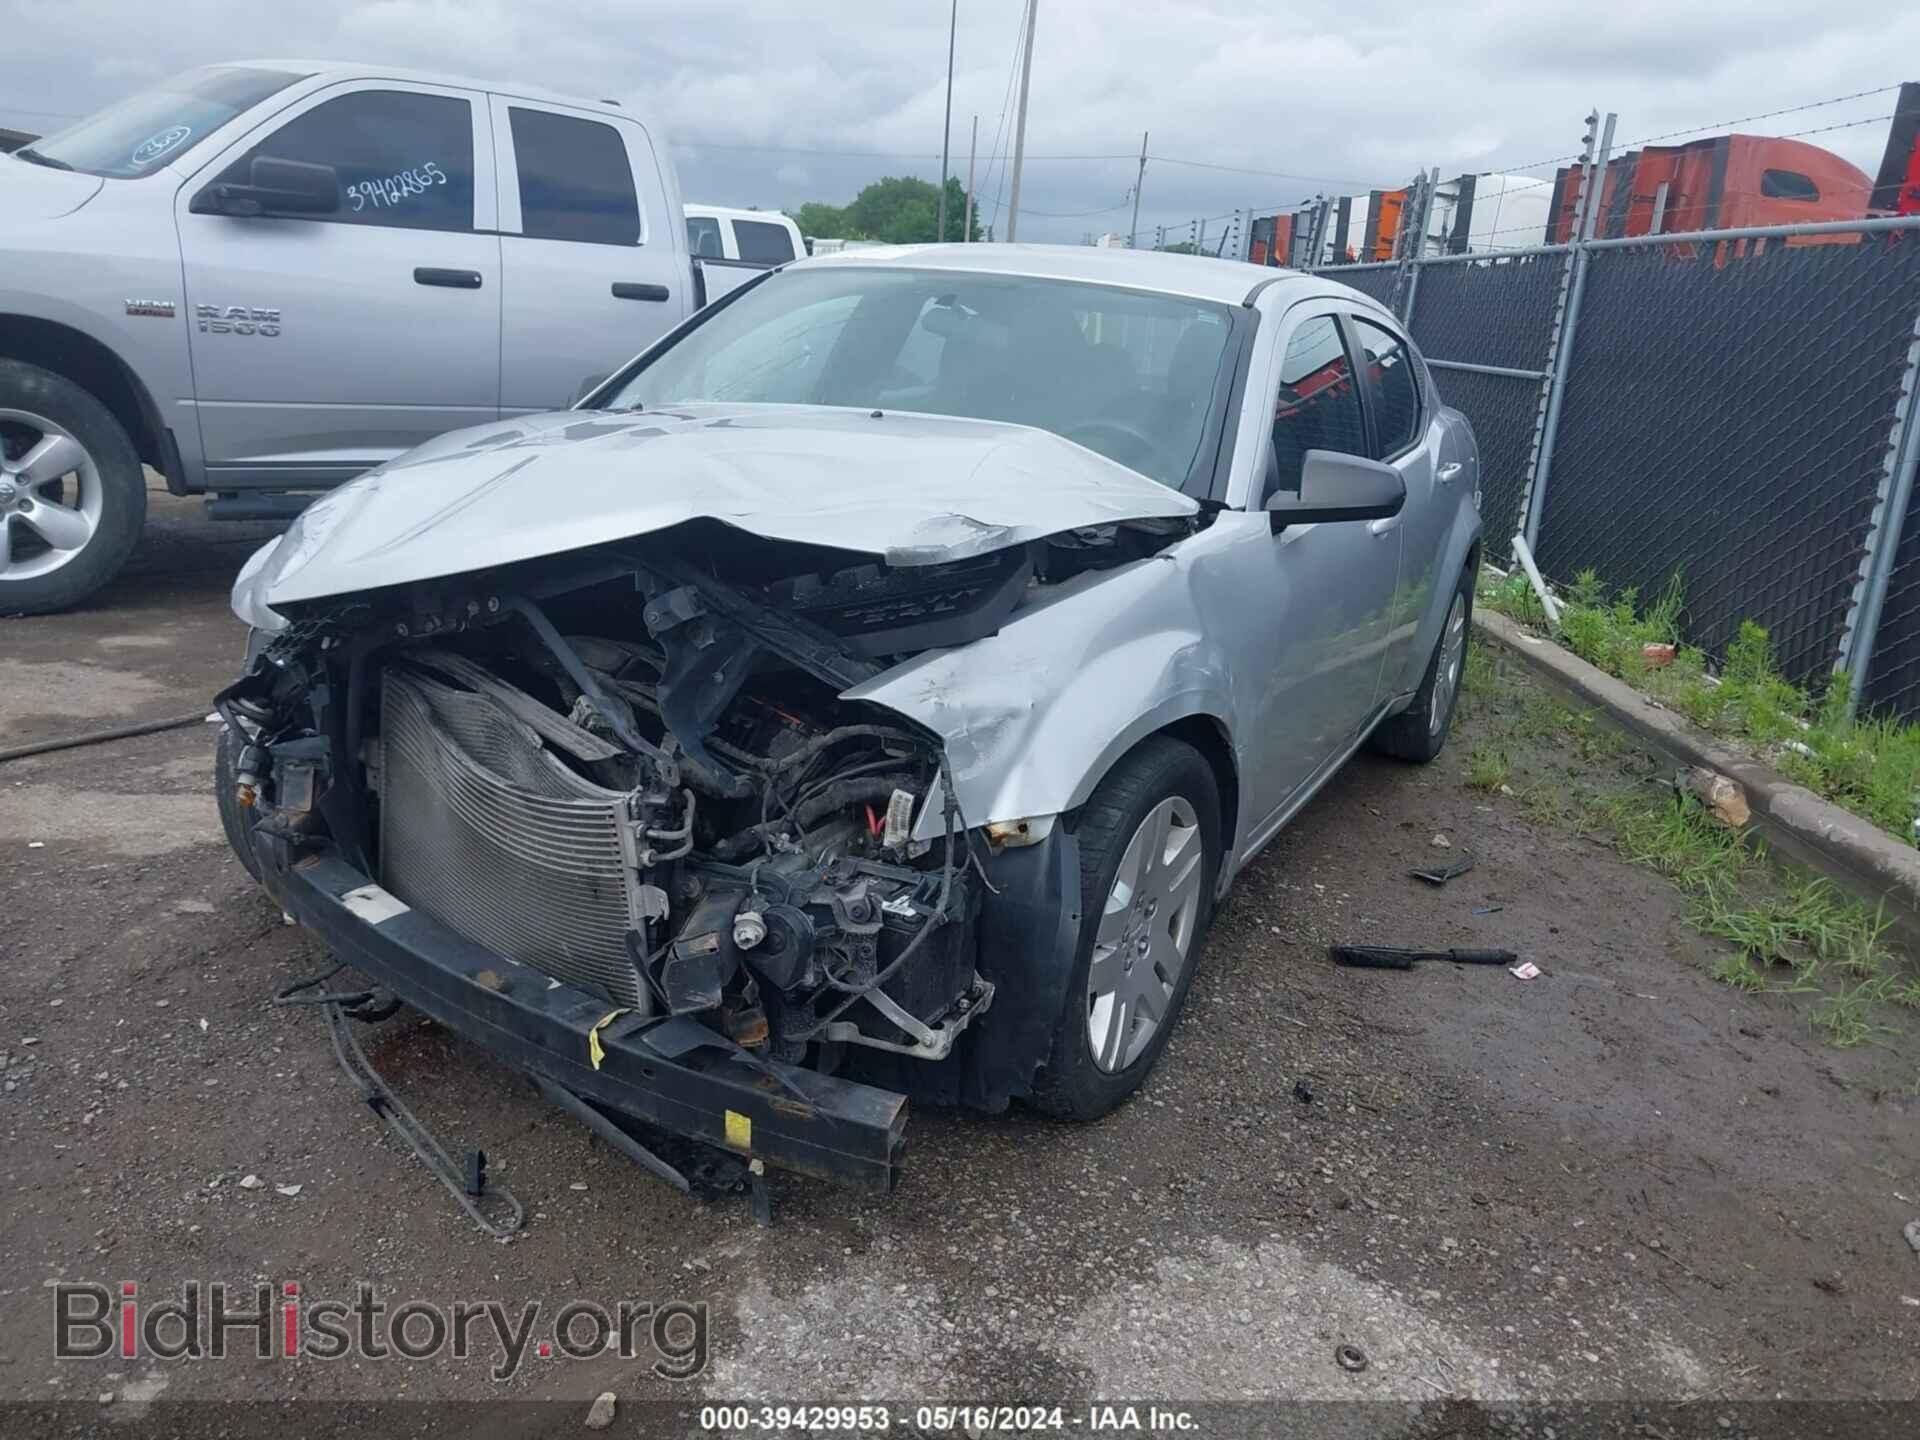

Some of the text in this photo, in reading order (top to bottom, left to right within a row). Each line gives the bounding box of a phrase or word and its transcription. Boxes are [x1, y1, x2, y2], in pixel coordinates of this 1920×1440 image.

[347, 161, 447, 212] 39422865
[196, 304, 280, 322] RAM
[198, 320, 281, 337] 1500
